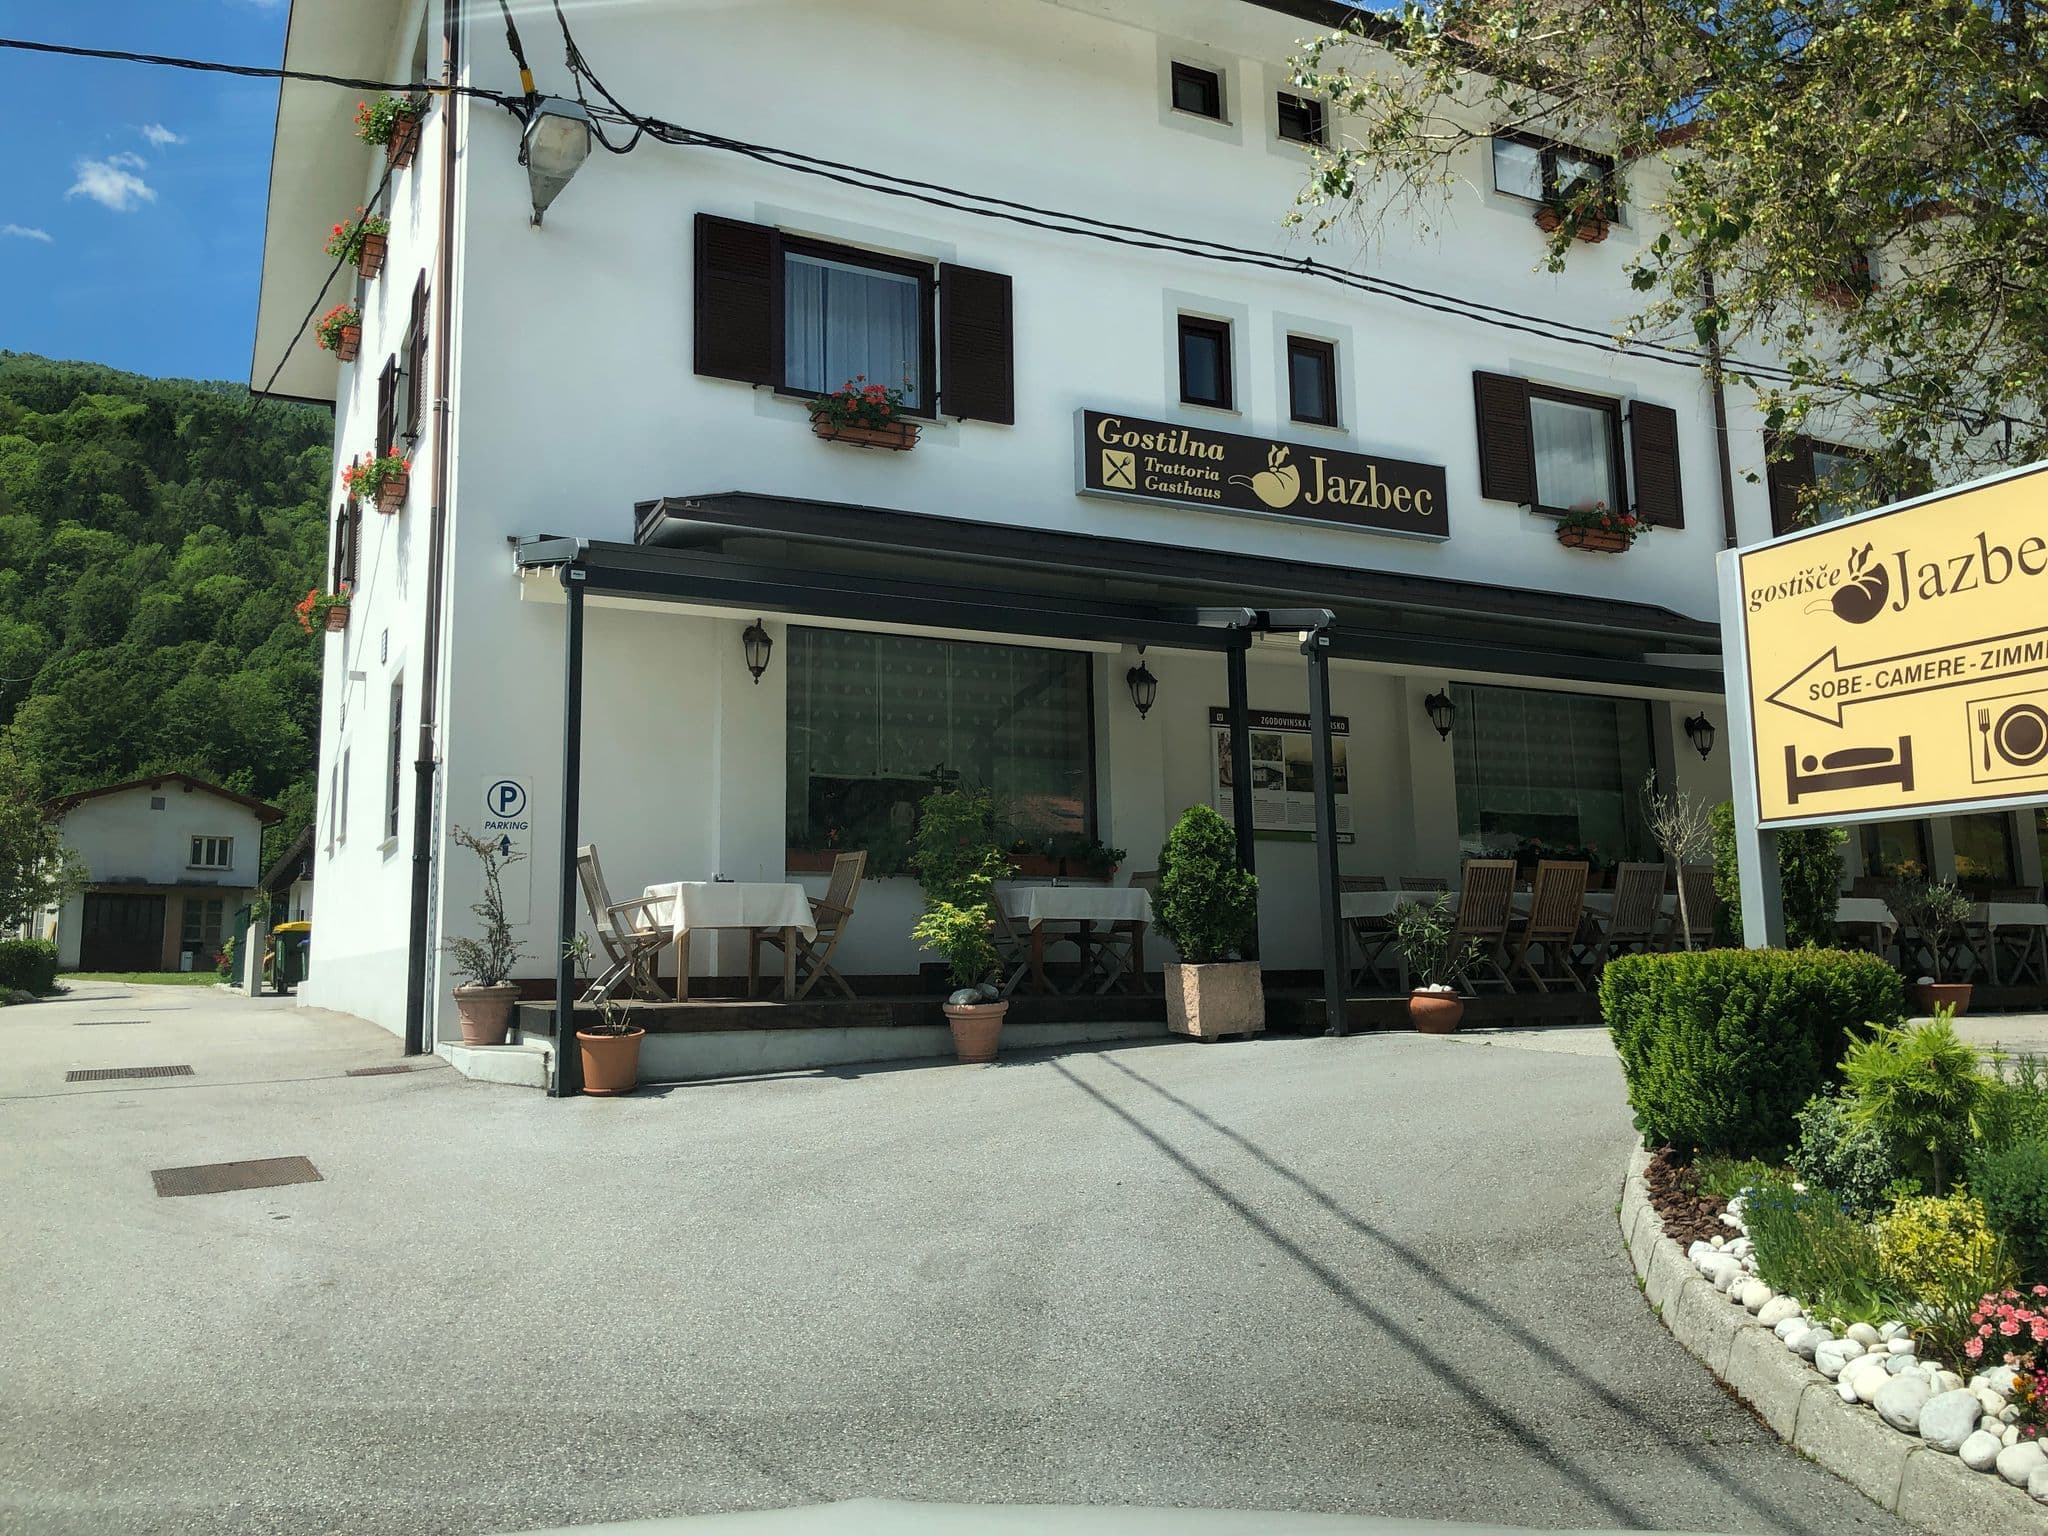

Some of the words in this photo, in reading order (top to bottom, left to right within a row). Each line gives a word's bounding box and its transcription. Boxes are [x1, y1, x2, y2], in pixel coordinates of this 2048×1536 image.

[1097, 417, 1225, 461] Gostilna
[1144, 456, 1220, 481] Trattoria
[1144, 475, 1221, 500] Gasthaus
[1304, 455, 1433, 516] Jazbec
[1749, 564, 1841, 612] gostišče
[1892, 531, 2048, 612] Jazbe
[1980, 639, 2048, 670] ZIMM
[1260, 716, 1307, 728] ZGODOVINSKA
[500, 786, 517, 812] P
[484, 821, 529, 830] PARKING
